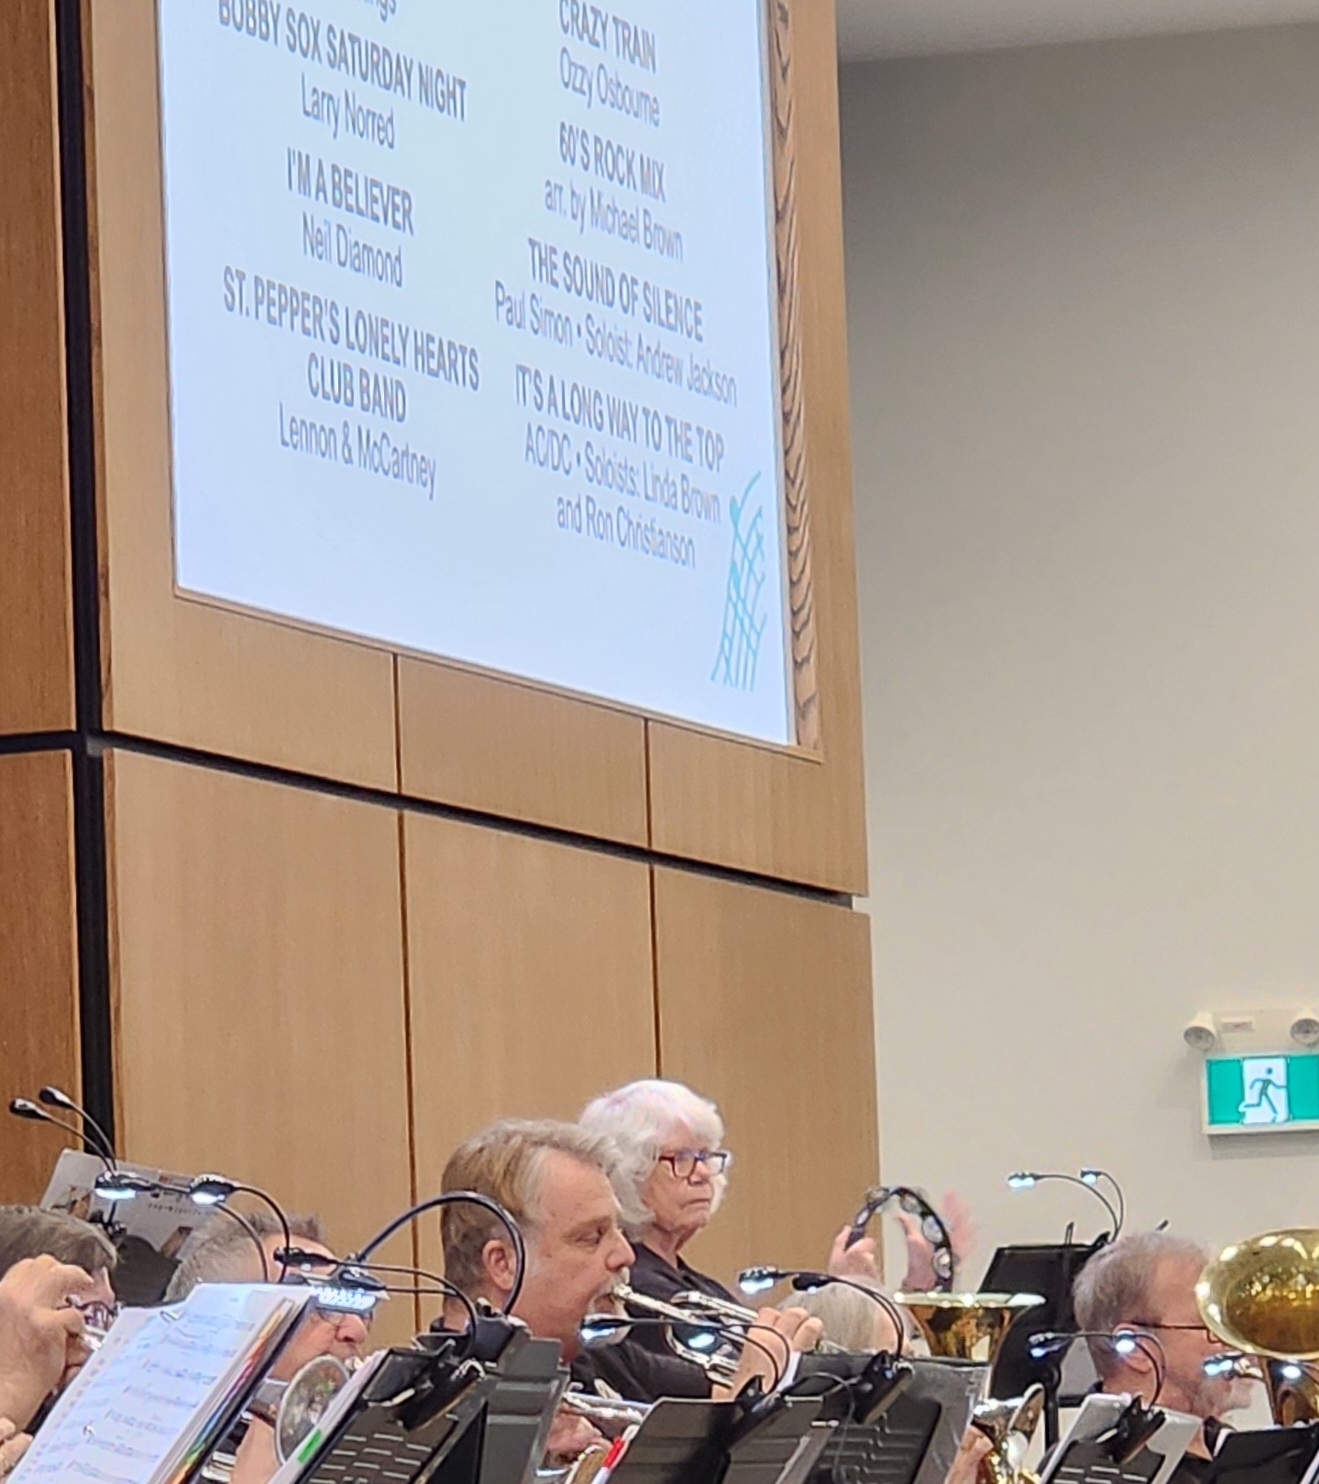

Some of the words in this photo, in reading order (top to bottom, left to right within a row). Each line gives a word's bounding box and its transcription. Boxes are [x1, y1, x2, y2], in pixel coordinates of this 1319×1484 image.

[286, 7, 323, 64] SOX
[327, 24, 414, 101] SATURDAY
[418, 61, 466, 122] NIGHT
[560, 0, 609, 51] CRAZY
[612, 15, 656, 73] TRAIN
[301, 72, 340, 139] Larry
[344, 89, 395, 149] Norred
[560, 46, 594, 109] Ozzy
[597, 63, 660, 127] Osbourne
[287, 147, 312, 198] I'M
[315, 158, 328, 204] A
[331, 163, 414, 236] BELIEVER
[560, 121, 590, 172] 60'S
[594, 134, 637, 192] ROCK
[640, 154, 666, 204] MIX
[303, 211, 332, 264] Neil
[336, 223, 402, 287] Diamond
[545, 179, 567, 217] arr.
[571, 179, 586, 235] by
[590, 186, 640, 244] Michael
[643, 208, 683, 262] Brown
[224, 265, 250, 317] ST.
[254, 274, 341, 346] PEPPER'S
[345, 306, 409, 368] LONELY
[413, 329, 479, 391] HEARTS
[528, 237, 559, 289] THE
[563, 251, 615, 308] SOUND
[619, 272, 638, 317] OF
[643, 281, 703, 343] SILENCE
[495, 280, 526, 330] Paul
[530, 293, 573, 347] Simon
[636, 332, 683, 388] Andrew
[686, 352, 737, 408] Jackson
[308, 352, 354, 408] CLUB
[359, 367, 407, 423] BAND
[516, 364, 543, 412] IT'S
[548, 374, 559, 418] A
[562, 379, 604, 432] LONG
[607, 394, 638, 444] WAY
[642, 406, 662, 452] TO
[665, 415, 693, 464] THE
[696, 425, 724, 473] TOP
[279, 401, 337, 462] Lennon
[342, 420, 353, 465] &
[357, 424, 436, 501] McCartney
[525, 421, 572, 476] AC/DC
[644, 460, 678, 511] Linda
[681, 473, 721, 524] Brown
[557, 493, 582, 533] and
[586, 495, 613, 543] Ron
[616, 505, 696, 569] Christianson
